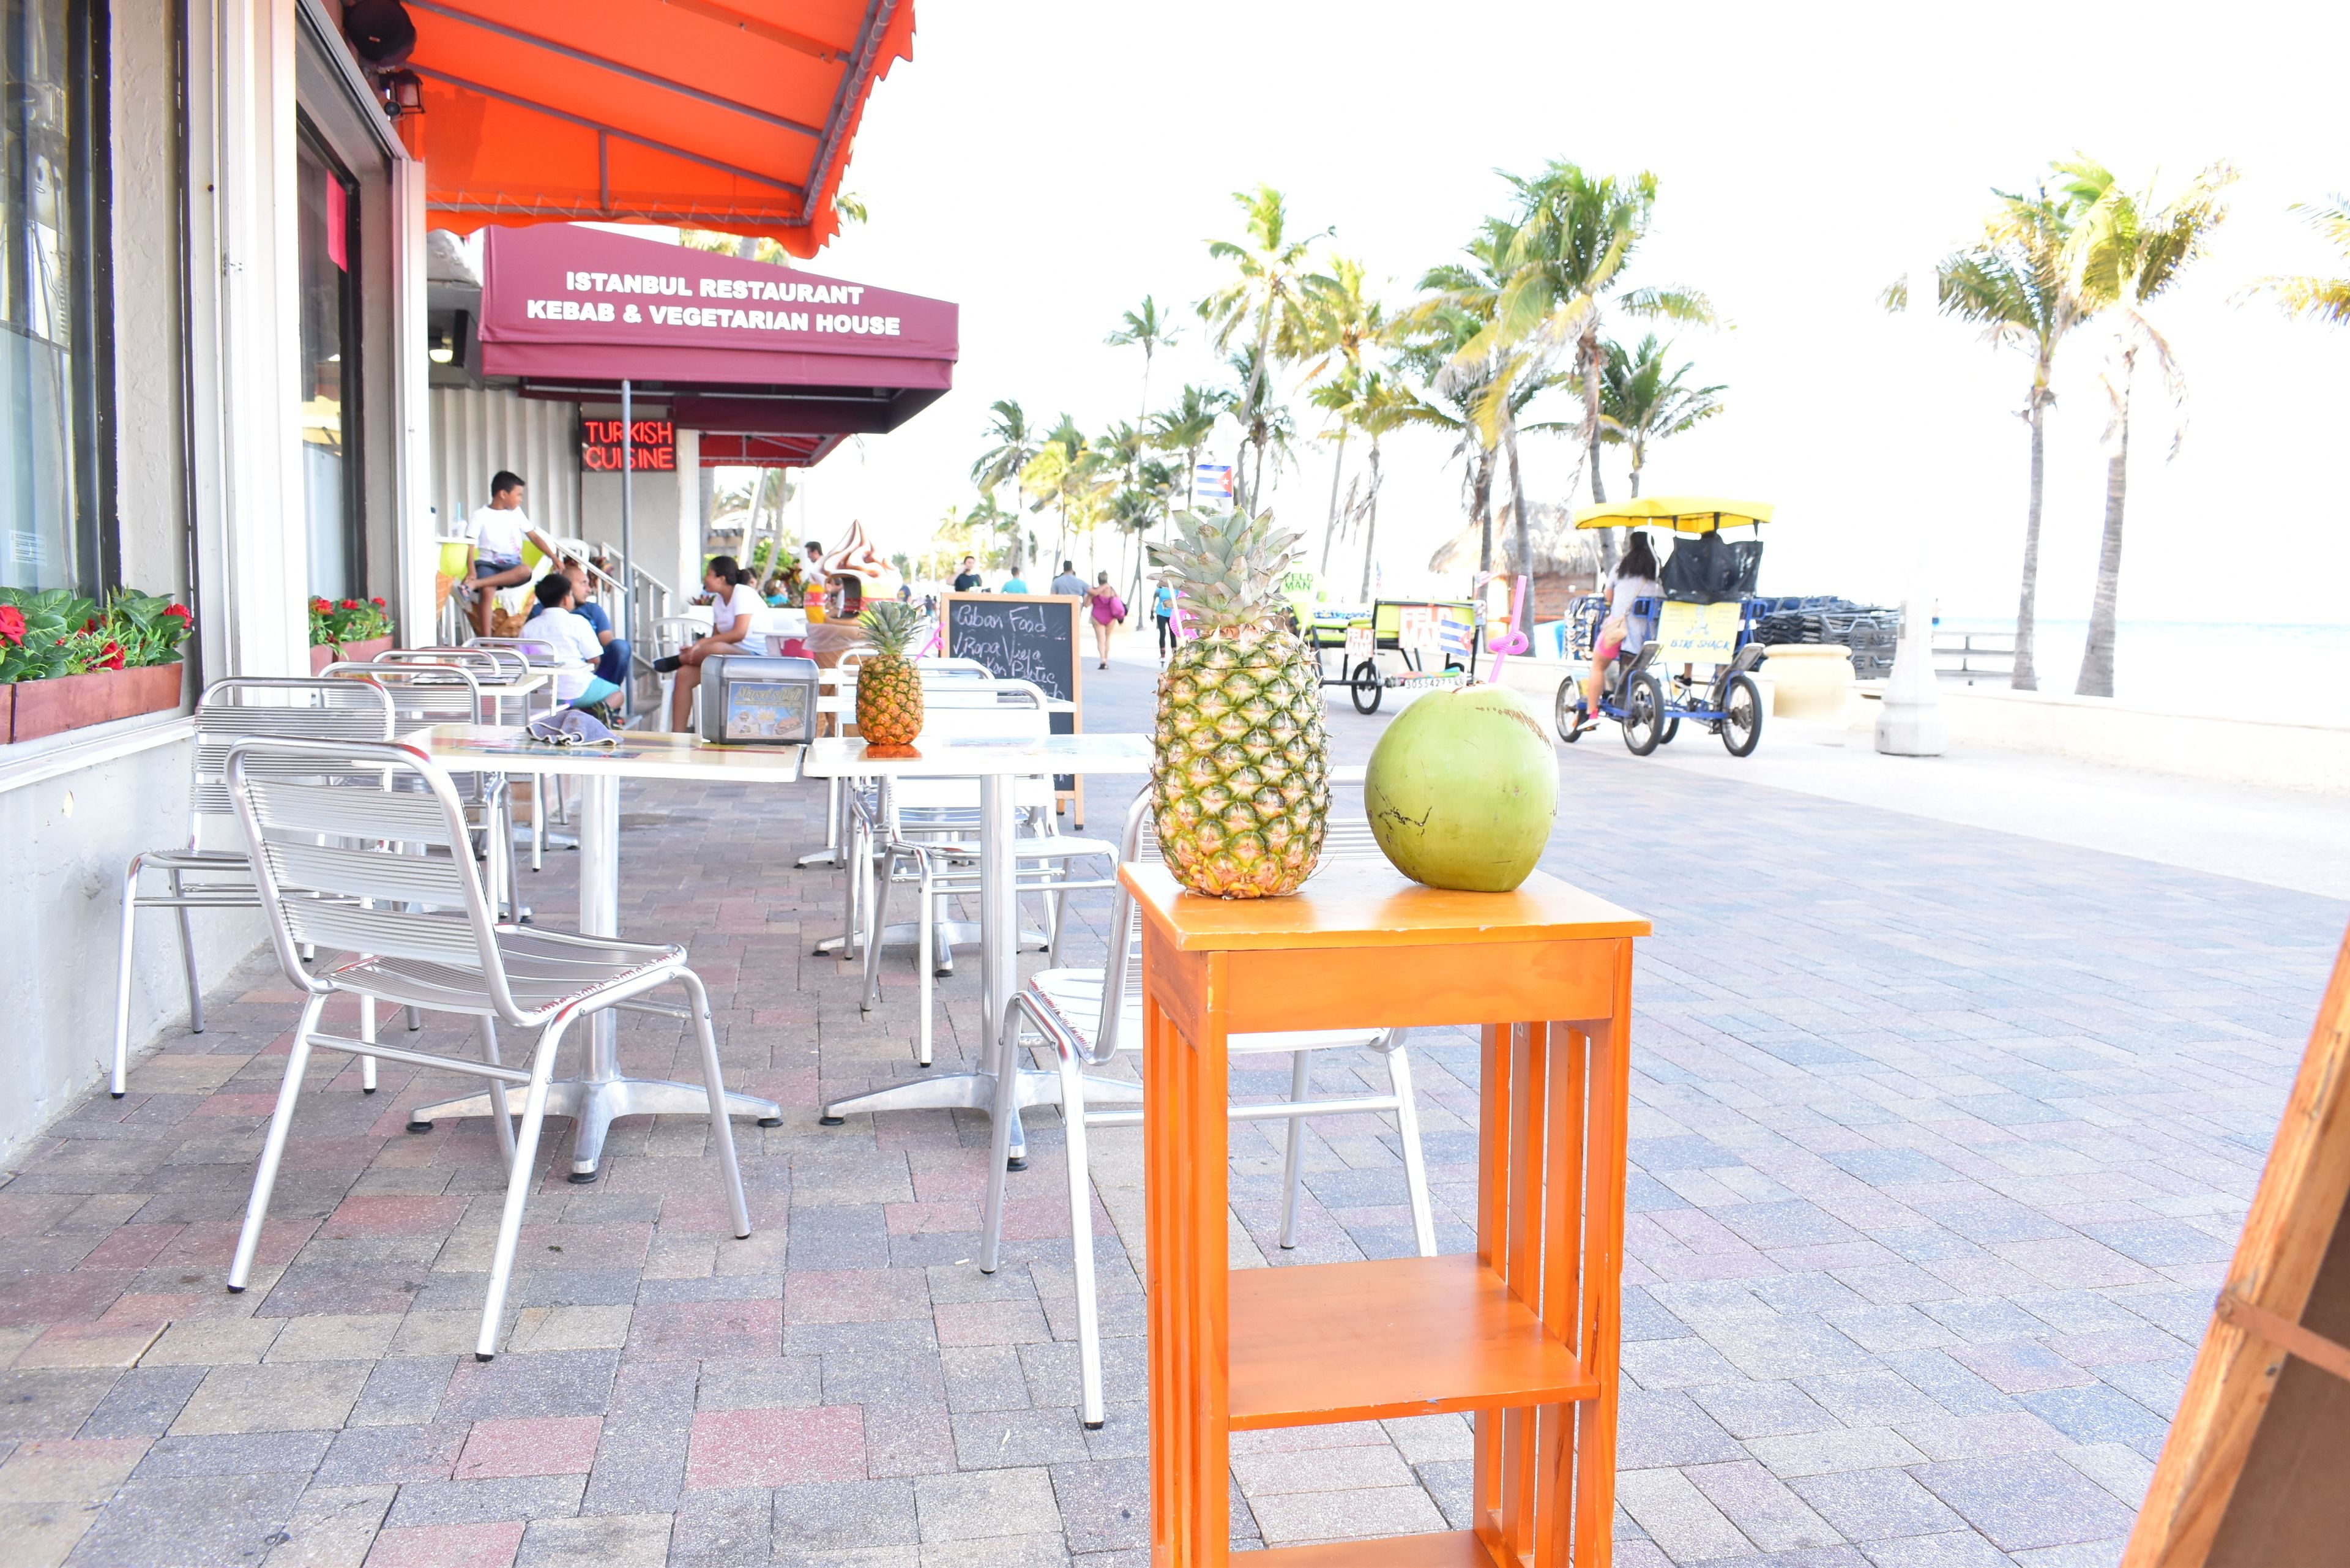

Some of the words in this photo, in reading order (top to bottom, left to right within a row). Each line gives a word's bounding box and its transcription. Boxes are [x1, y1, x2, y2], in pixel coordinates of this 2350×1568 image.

[567, 271, 693, 296] ISTANBUL
[700, 278, 864, 305] RESTAURANT
[528, 299, 615, 322] KEBAB
[623, 304, 642, 323] &
[649, 305, 808, 331] VEGETARIAN
[816, 313, 900, 335] HOUSE
[585, 421, 673, 444] TURKISH
[586, 446, 674, 469] CUISINE
[958, 604, 1003, 629] Cuban
[1009, 605, 1046, 633] Food
[963, 637, 1001, 657] Ropa
[1670, 640, 1695, 650] BIKE
[1697, 640, 1729, 651] SHACK
